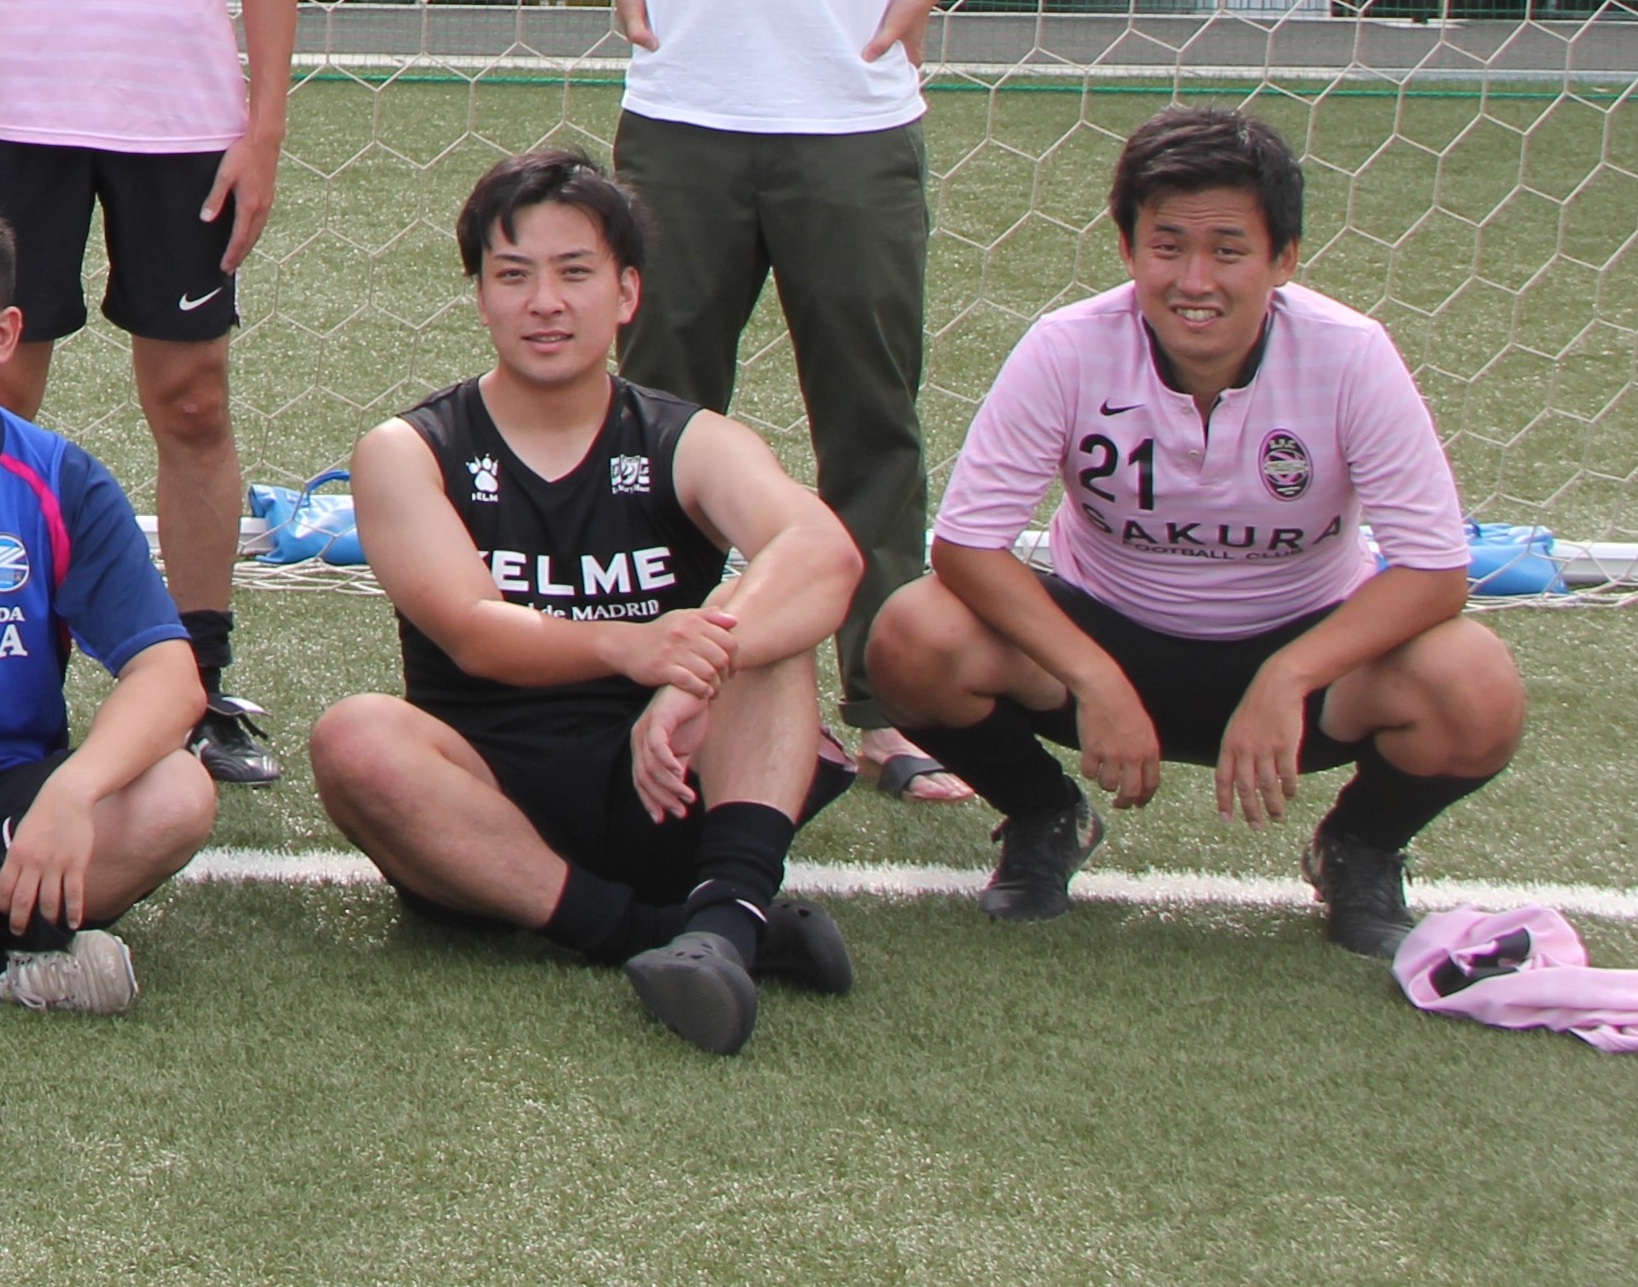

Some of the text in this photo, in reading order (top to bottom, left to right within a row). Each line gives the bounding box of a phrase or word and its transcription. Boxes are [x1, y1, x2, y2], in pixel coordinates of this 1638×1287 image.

[1079, 434, 1155, 511] 21
[1082, 502, 1342, 550] SAKURA
[479, 547, 675, 596] ELME
[572, 599, 659, 621] MADRID
